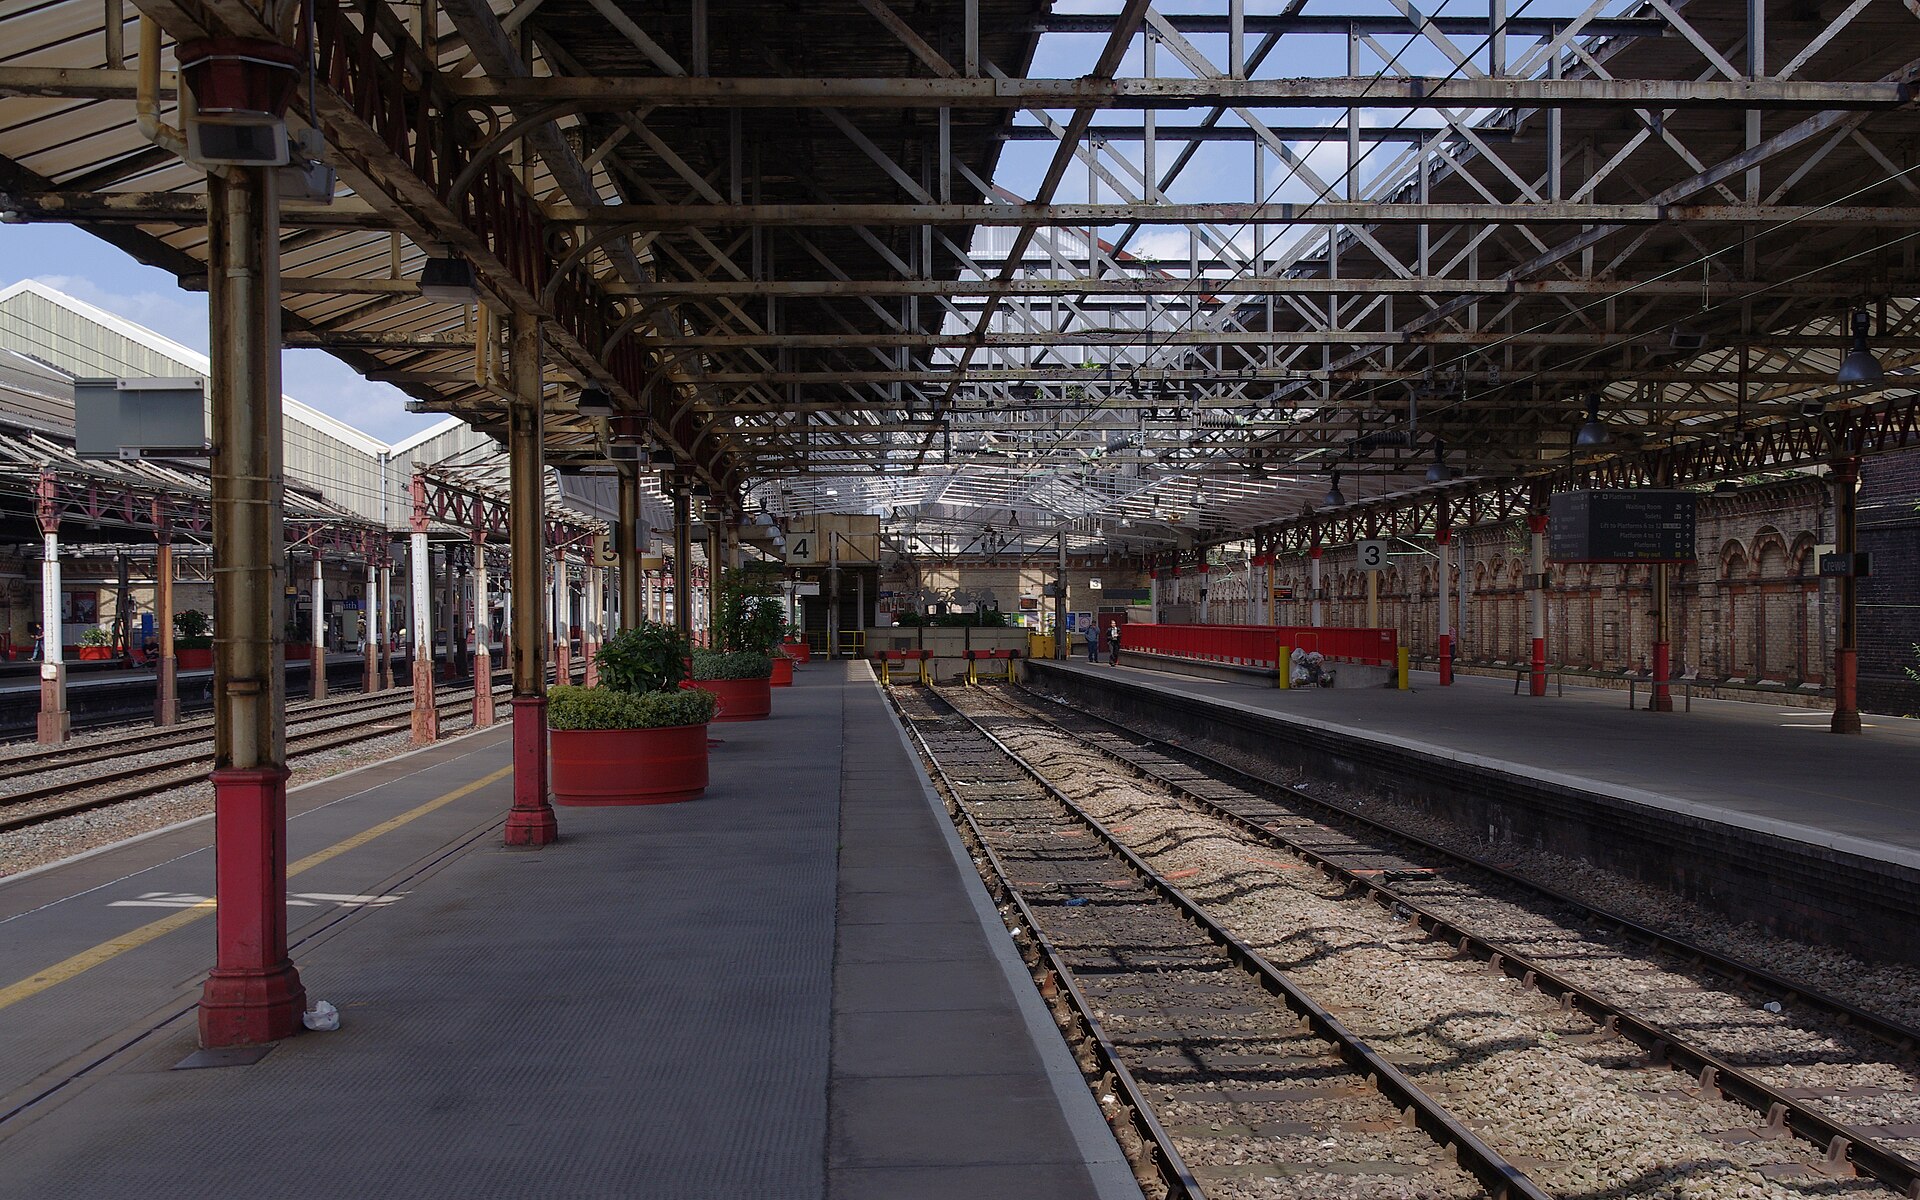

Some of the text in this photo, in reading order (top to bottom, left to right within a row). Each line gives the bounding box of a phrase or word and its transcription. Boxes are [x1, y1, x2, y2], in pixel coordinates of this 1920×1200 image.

[603, 541, 617, 561] 5
[793, 538, 808, 558] 4
[1365, 546, 1380, 567] 3
[1637, 551, 1650, 559] Way
[1822, 558, 1846, 572] Crewe
[353, 586, 360, 594] 6
